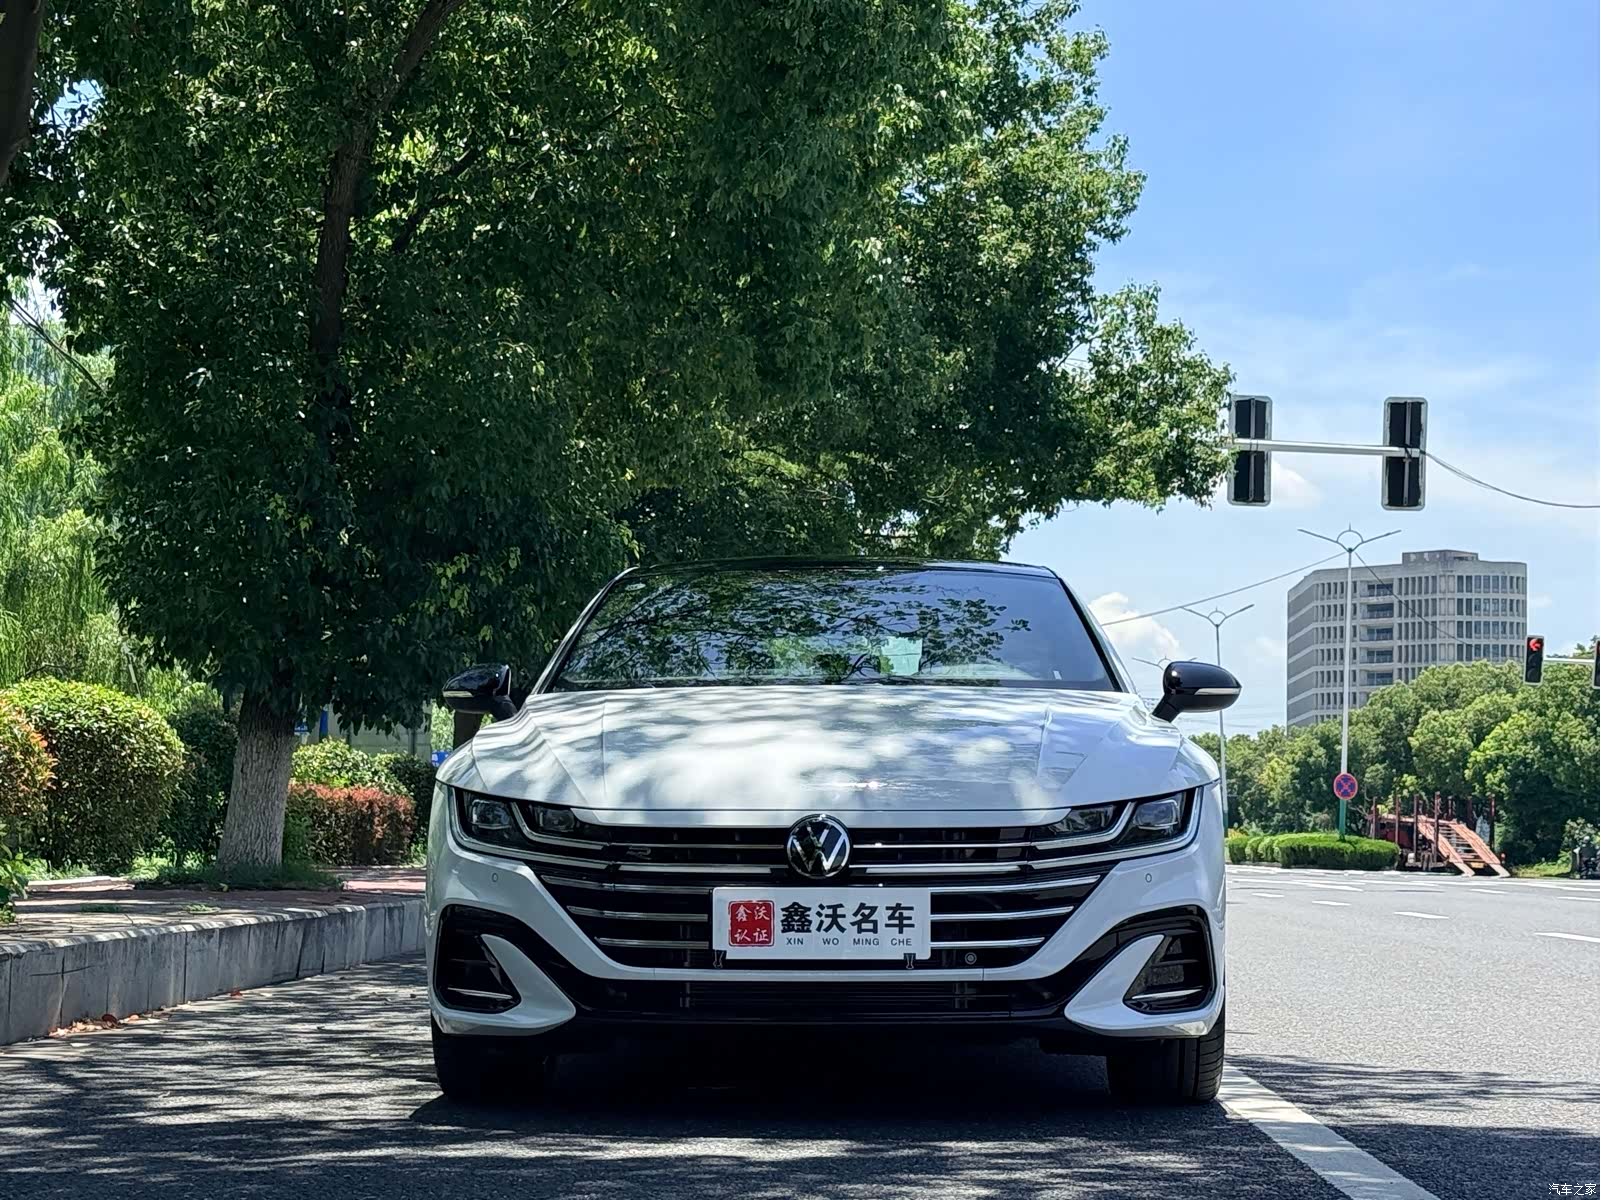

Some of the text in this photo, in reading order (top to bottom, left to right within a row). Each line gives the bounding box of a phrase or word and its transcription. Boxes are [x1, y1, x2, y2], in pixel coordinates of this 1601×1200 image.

[735, 904, 770, 922] 鑫沃
[781, 901, 915, 935] 鑫沃名车
[734, 928, 769, 943] 认证
[786, 937, 912, 946] XIN WO MING CHE
